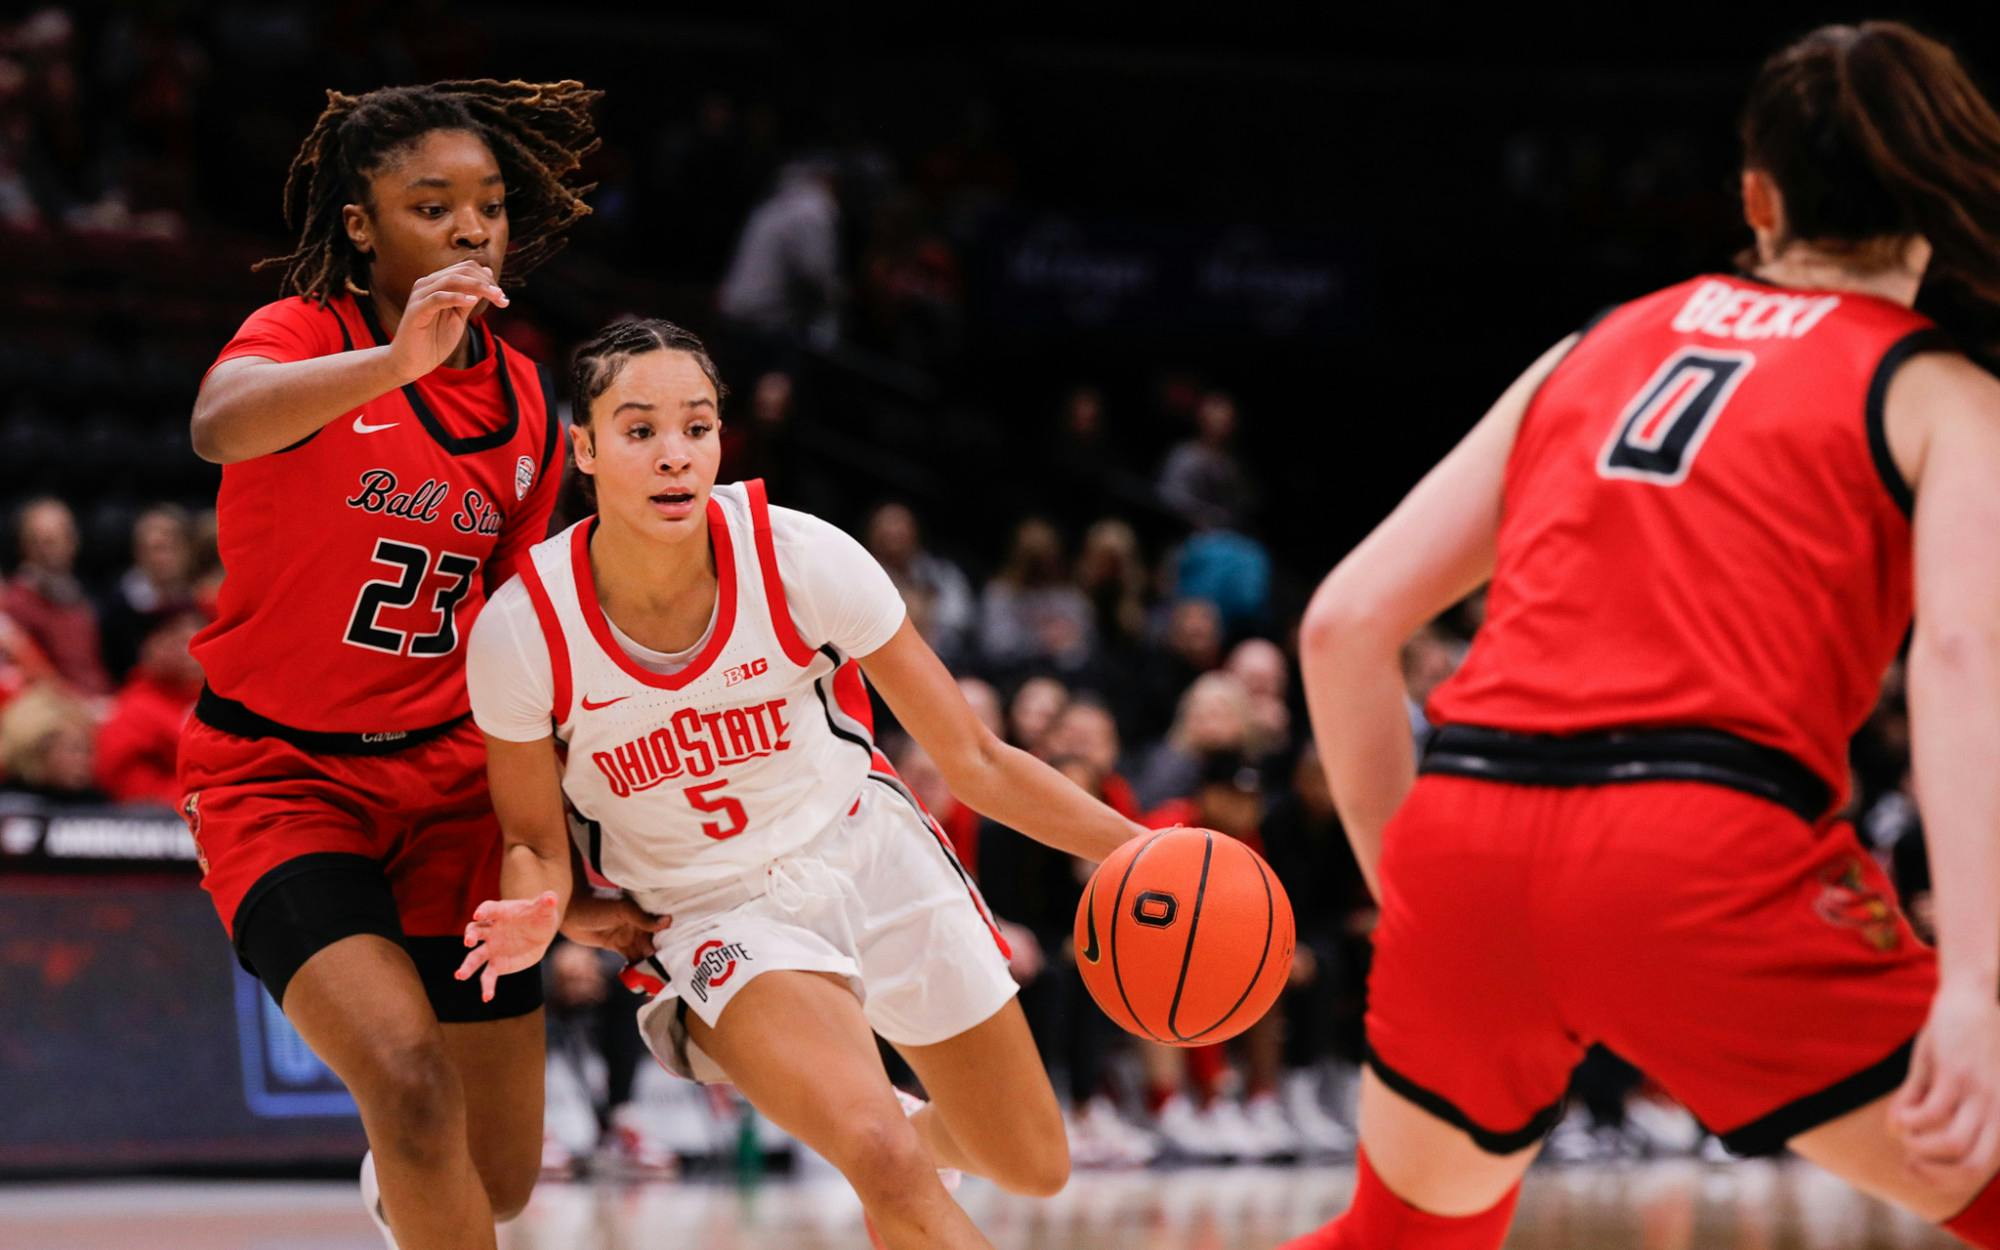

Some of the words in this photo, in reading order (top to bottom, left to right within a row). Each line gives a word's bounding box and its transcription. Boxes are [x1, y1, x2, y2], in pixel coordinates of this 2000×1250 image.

[1670, 279, 1842, 340] BECKI
[1596, 344, 1757, 487] 0
[346, 468, 450, 524] Ball
[451, 488, 502, 537] Sta
[342, 537, 480, 658] 23
[683, 778, 749, 841] 5
